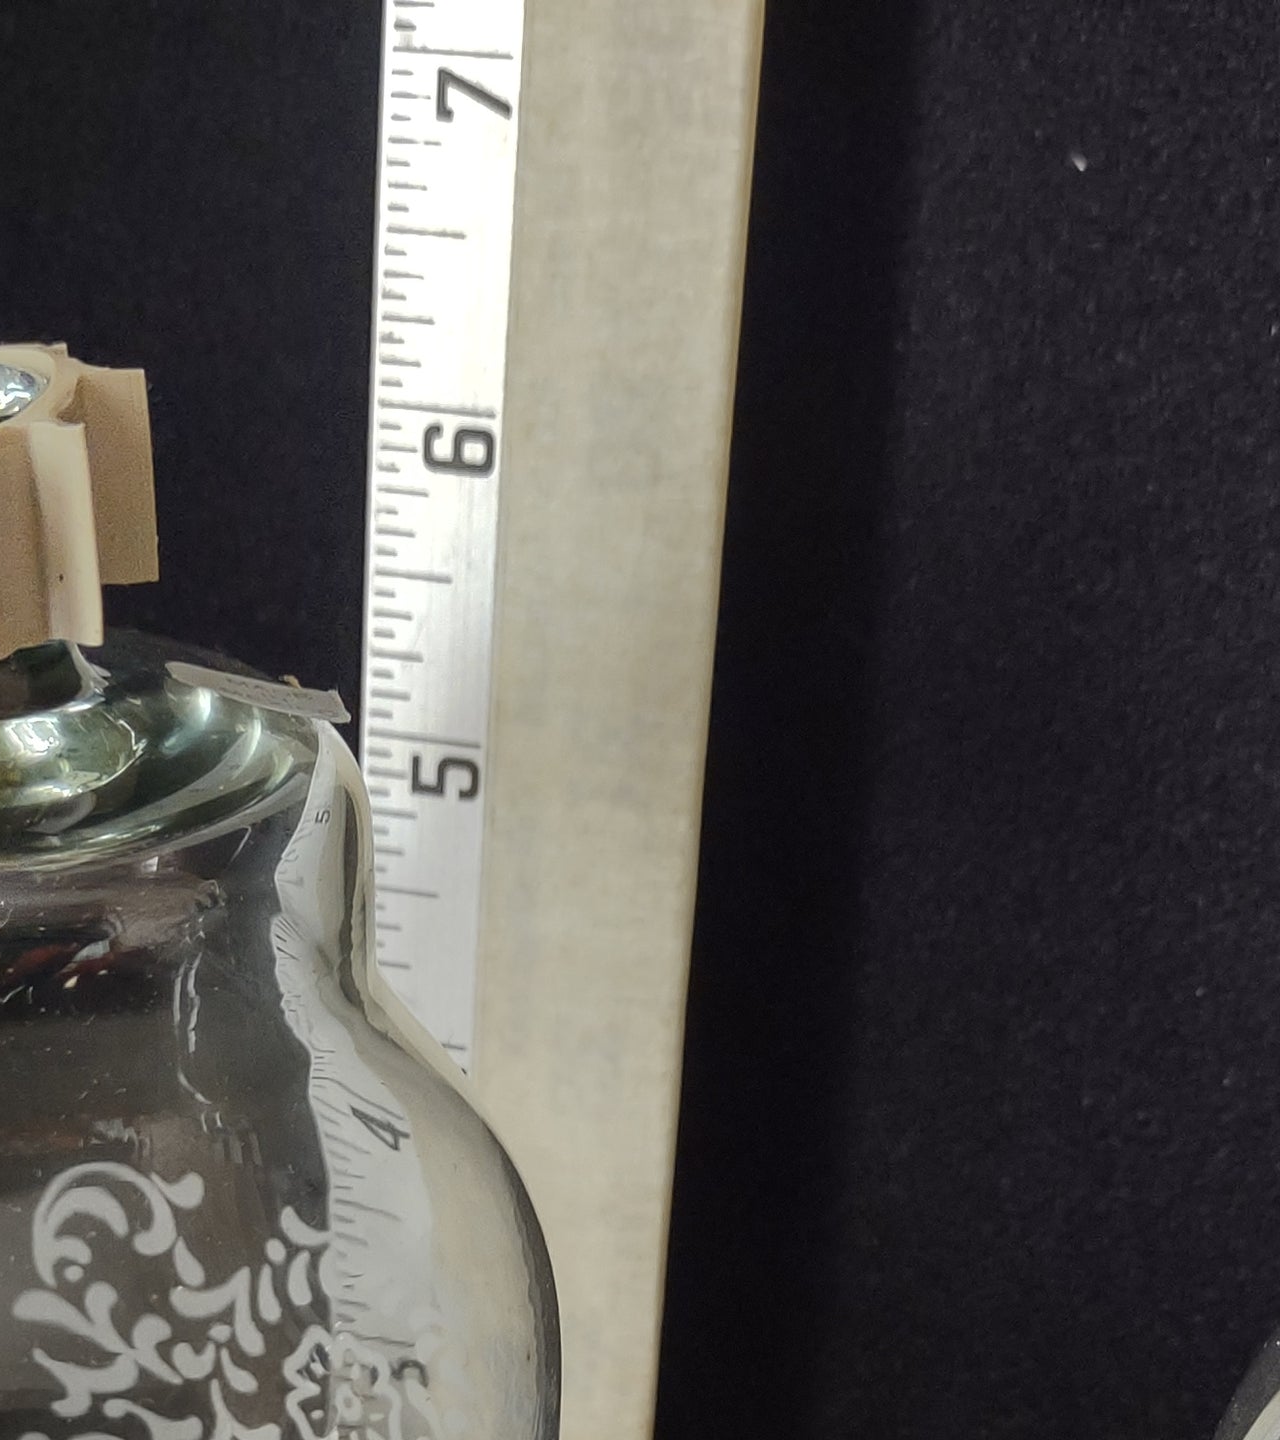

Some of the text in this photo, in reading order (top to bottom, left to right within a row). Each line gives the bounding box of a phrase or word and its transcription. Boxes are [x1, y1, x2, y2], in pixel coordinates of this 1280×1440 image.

[435, 66, 513, 122] 7
[423, 423, 497, 479] 6
[412, 755, 479, 801] 5
[349, 1105, 411, 1151] 4
